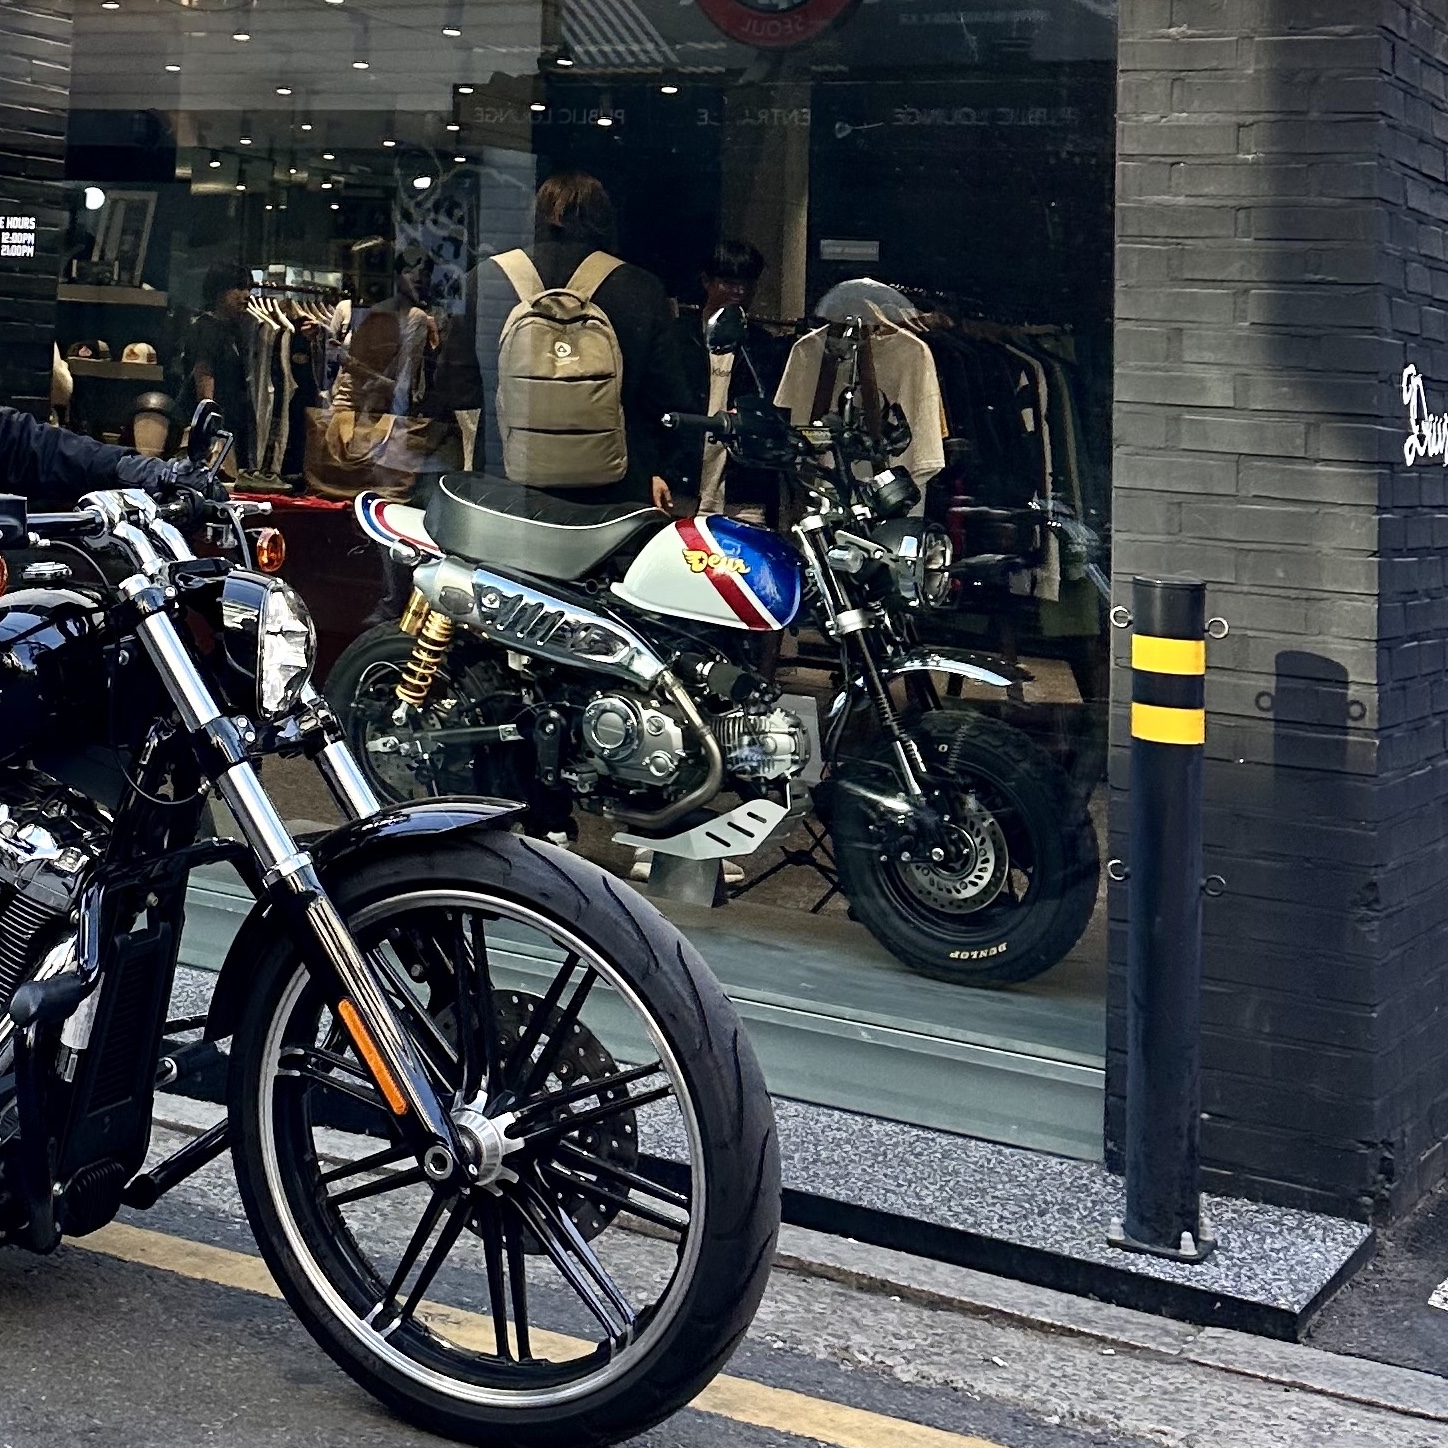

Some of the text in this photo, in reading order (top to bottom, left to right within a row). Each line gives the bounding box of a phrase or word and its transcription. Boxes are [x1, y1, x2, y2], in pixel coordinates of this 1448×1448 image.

[6, 216, 36, 230] HOURS
[681, 547, 752, 574] Deus
[949, 941, 1008, 960] DUNLOP
